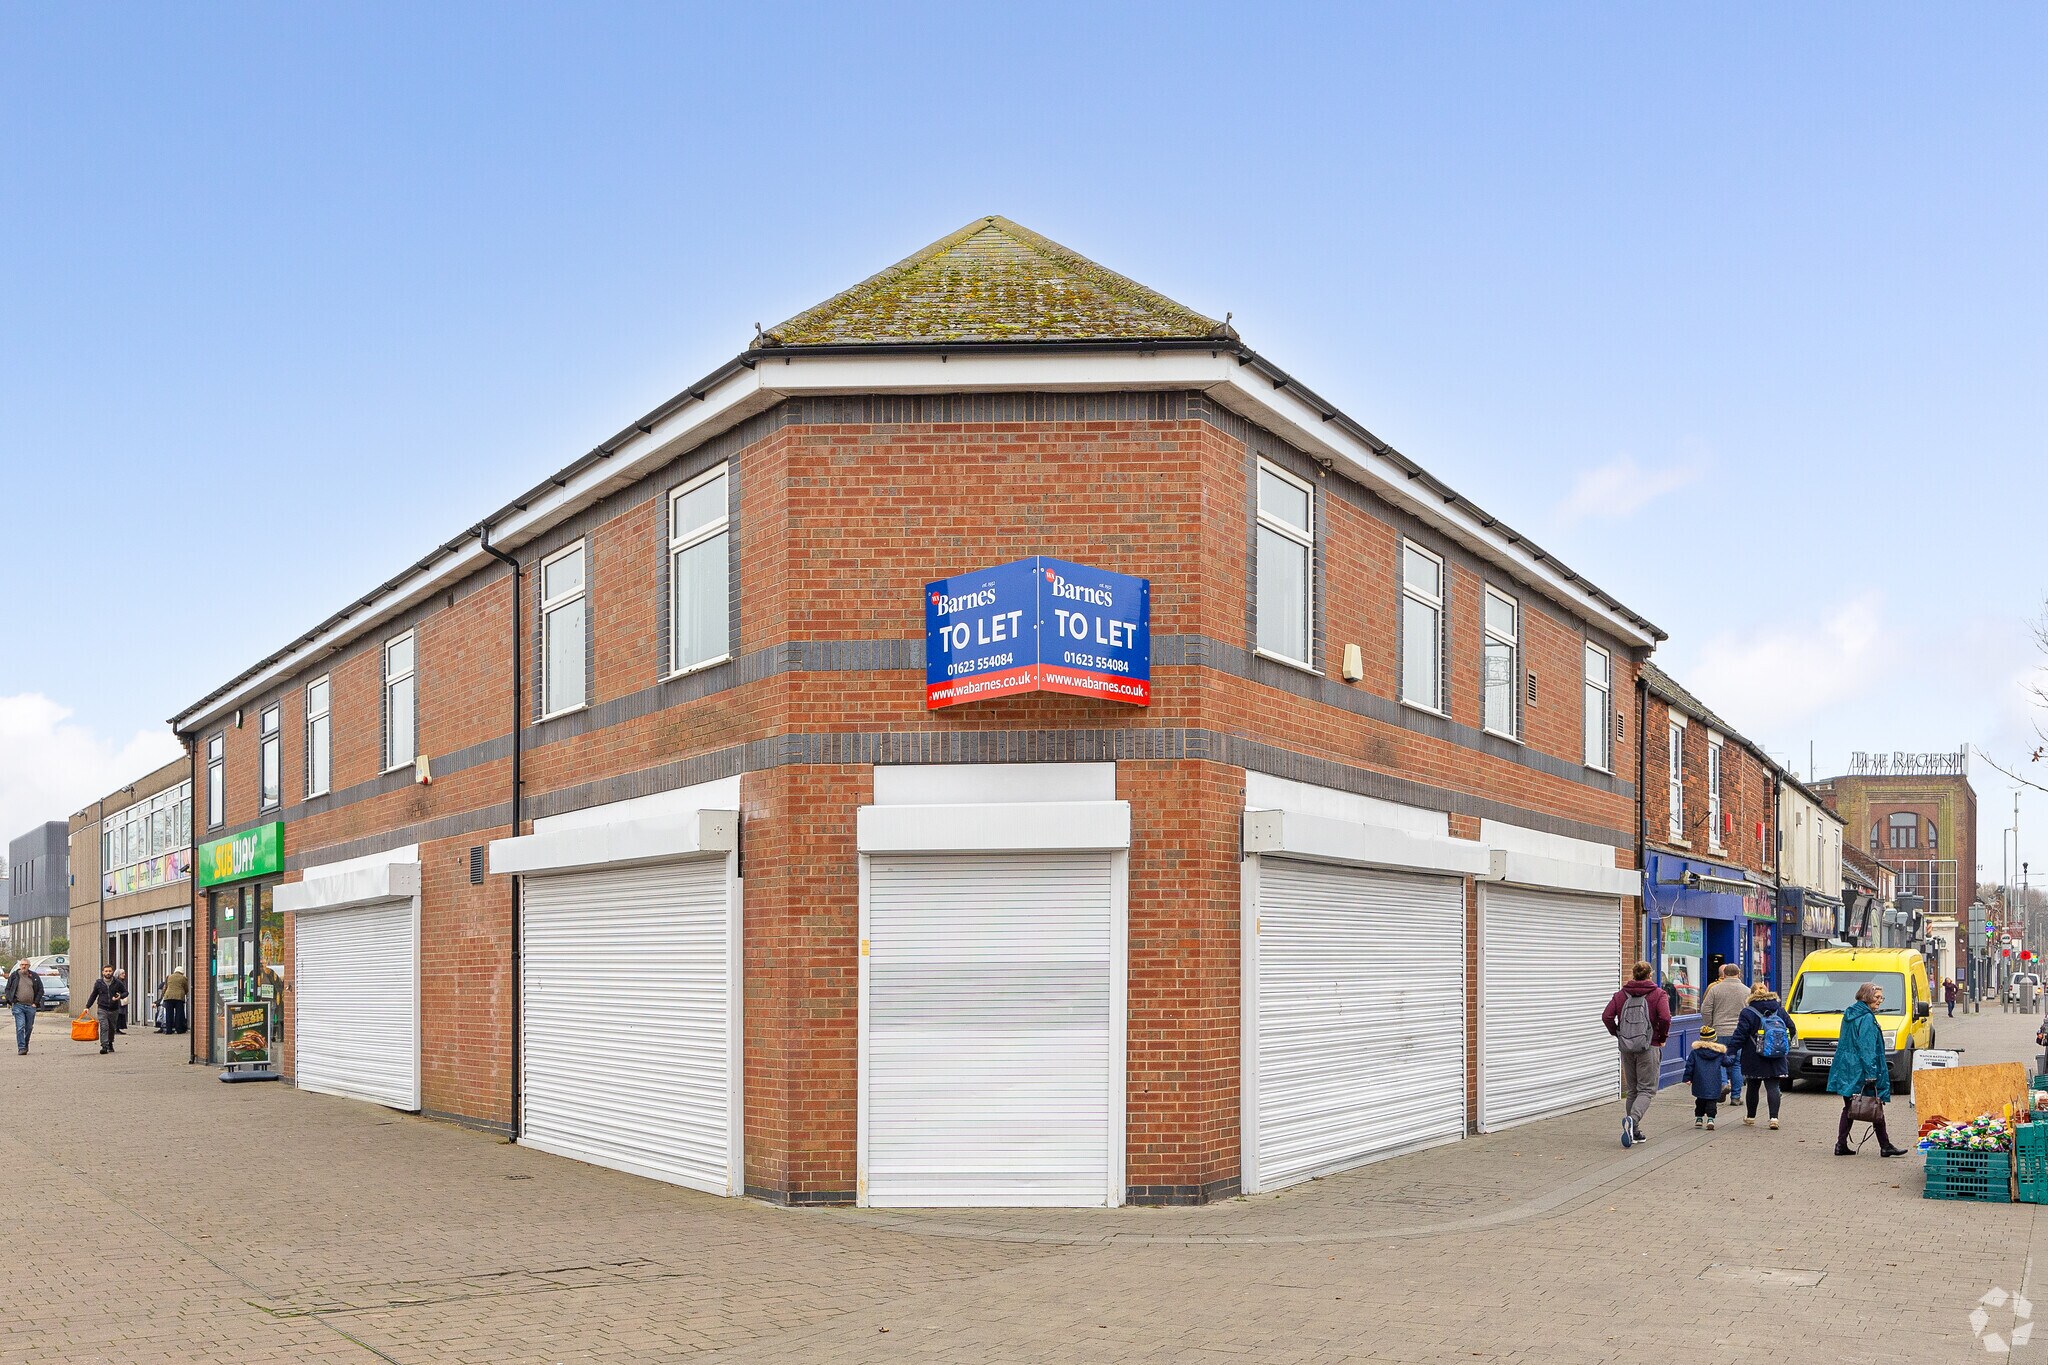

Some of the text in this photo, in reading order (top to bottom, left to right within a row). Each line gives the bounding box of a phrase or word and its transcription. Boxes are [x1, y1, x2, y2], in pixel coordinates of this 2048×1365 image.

[937, 588, 996, 617] Barnes
[1052, 575, 1113, 607] Barnes
[939, 610, 1023, 653] TO LET
[1054, 609, 1137, 649] TO LET
[947, 652, 1013, 676] 01623 554084
[1064, 650, 1129, 673] 01623 554084
[932, 671, 1031, 700] www.wabarnes.co.uk
[1046, 672, 1144, 697] www.wabarnes.co.uk
[1852, 751, 1965, 768] THE REGENT
[214, 832, 258, 879] SUBWAY
